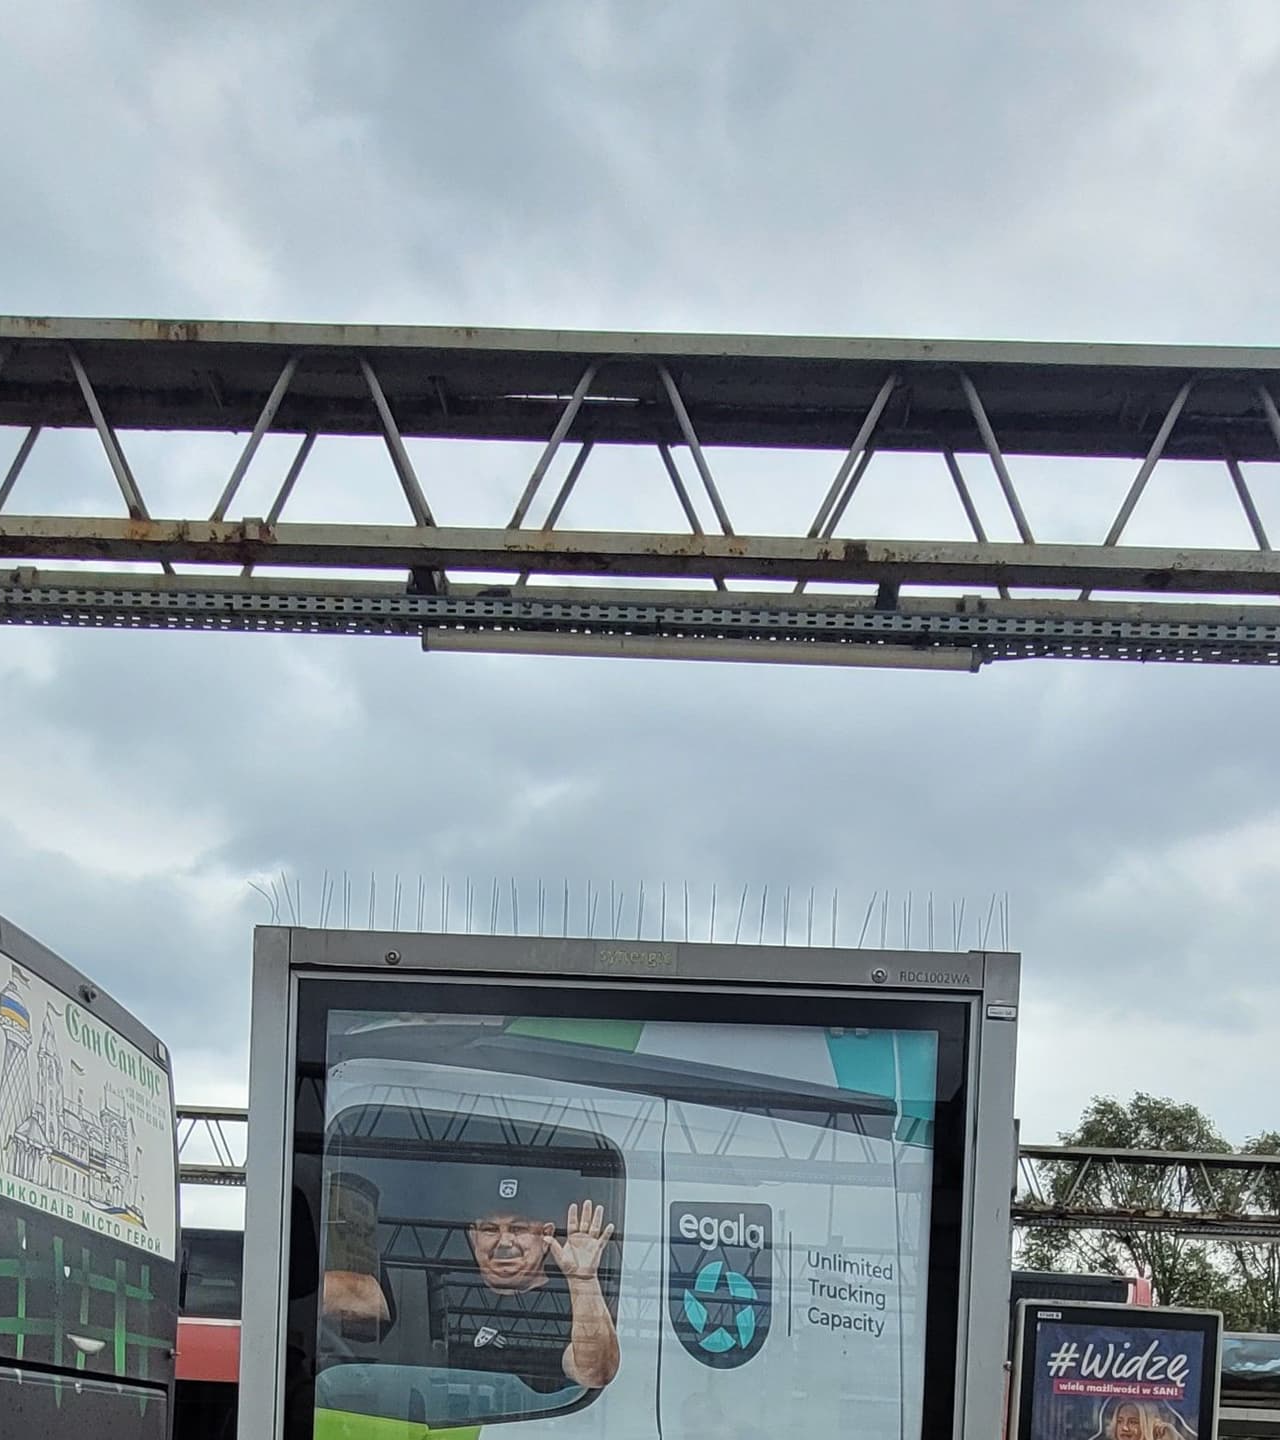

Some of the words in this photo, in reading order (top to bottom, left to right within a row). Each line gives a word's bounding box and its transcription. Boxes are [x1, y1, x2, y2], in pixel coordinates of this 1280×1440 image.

[81, 1209, 121, 1237] МІСТО
[126, 1229, 161, 1253] ГЕРОЙ
[679, 1213, 765, 1251] egala
[807, 1250, 893, 1281] Unlimited
[807, 1278, 886, 1310] Trucking
[807, 1307, 885, 1338] Capacity
[1047, 1340, 1190, 1388] #Widzę
[1059, 1381, 1084, 1391] wiele
[1086, 1383, 1140, 1395] możliwości
[1142, 1387, 1151, 1395] w
[1153, 1386, 1179, 1396] SAN!
